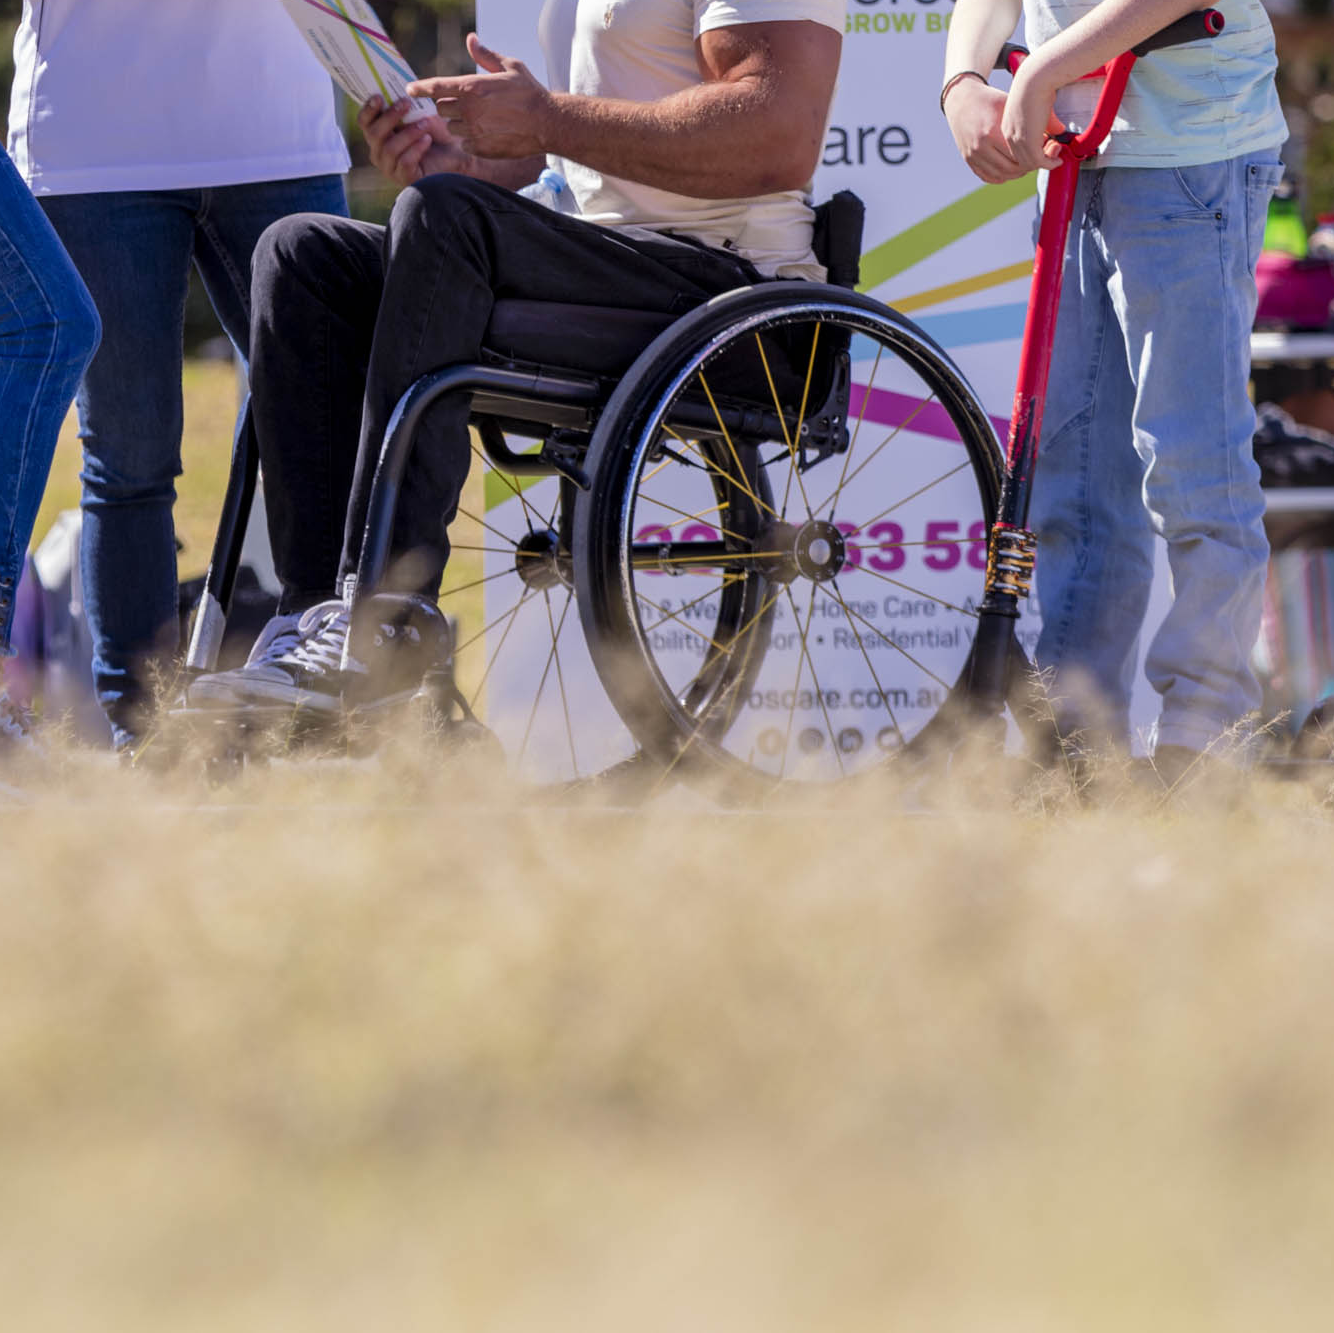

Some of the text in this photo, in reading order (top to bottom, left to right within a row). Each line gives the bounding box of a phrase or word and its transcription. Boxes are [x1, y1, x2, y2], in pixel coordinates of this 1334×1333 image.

[822, 125, 911, 167] are
[811, 597, 878, 619] Home
[883, 595, 936, 618] Care
[832, 624, 959, 651] Residential
